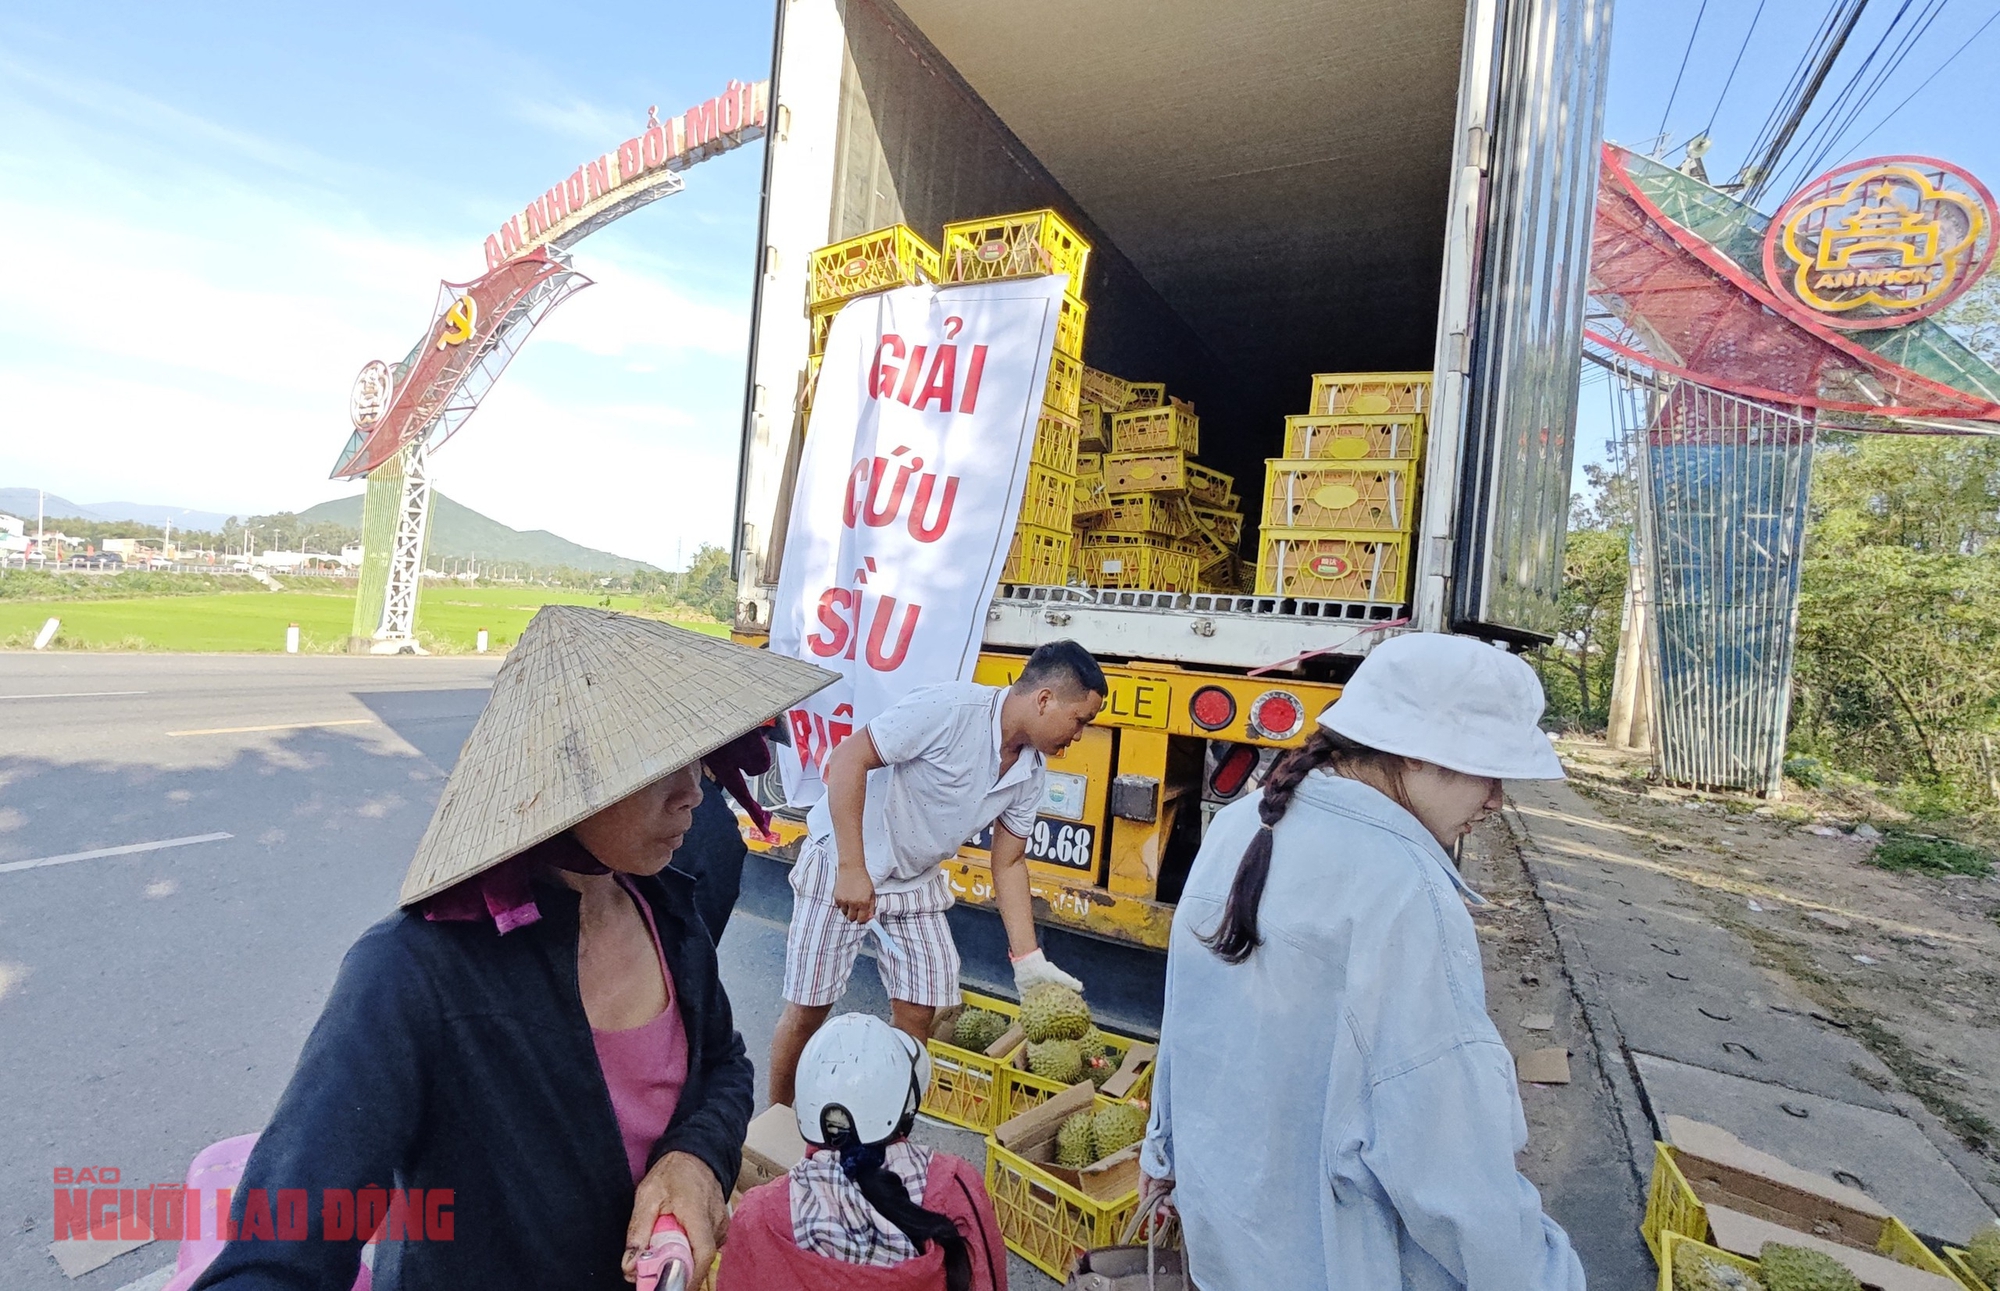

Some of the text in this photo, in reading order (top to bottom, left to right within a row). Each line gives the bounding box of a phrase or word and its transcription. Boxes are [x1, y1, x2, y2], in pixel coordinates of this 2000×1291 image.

[485, 214, 521, 271] AN
[527, 155, 611, 240] NHƠN
[619, 105, 675, 182] ĐỔI
[1814, 272, 1855, 289] AN
[869, 316, 988, 415] GIẢI
[843, 445, 960, 543] CỨU
